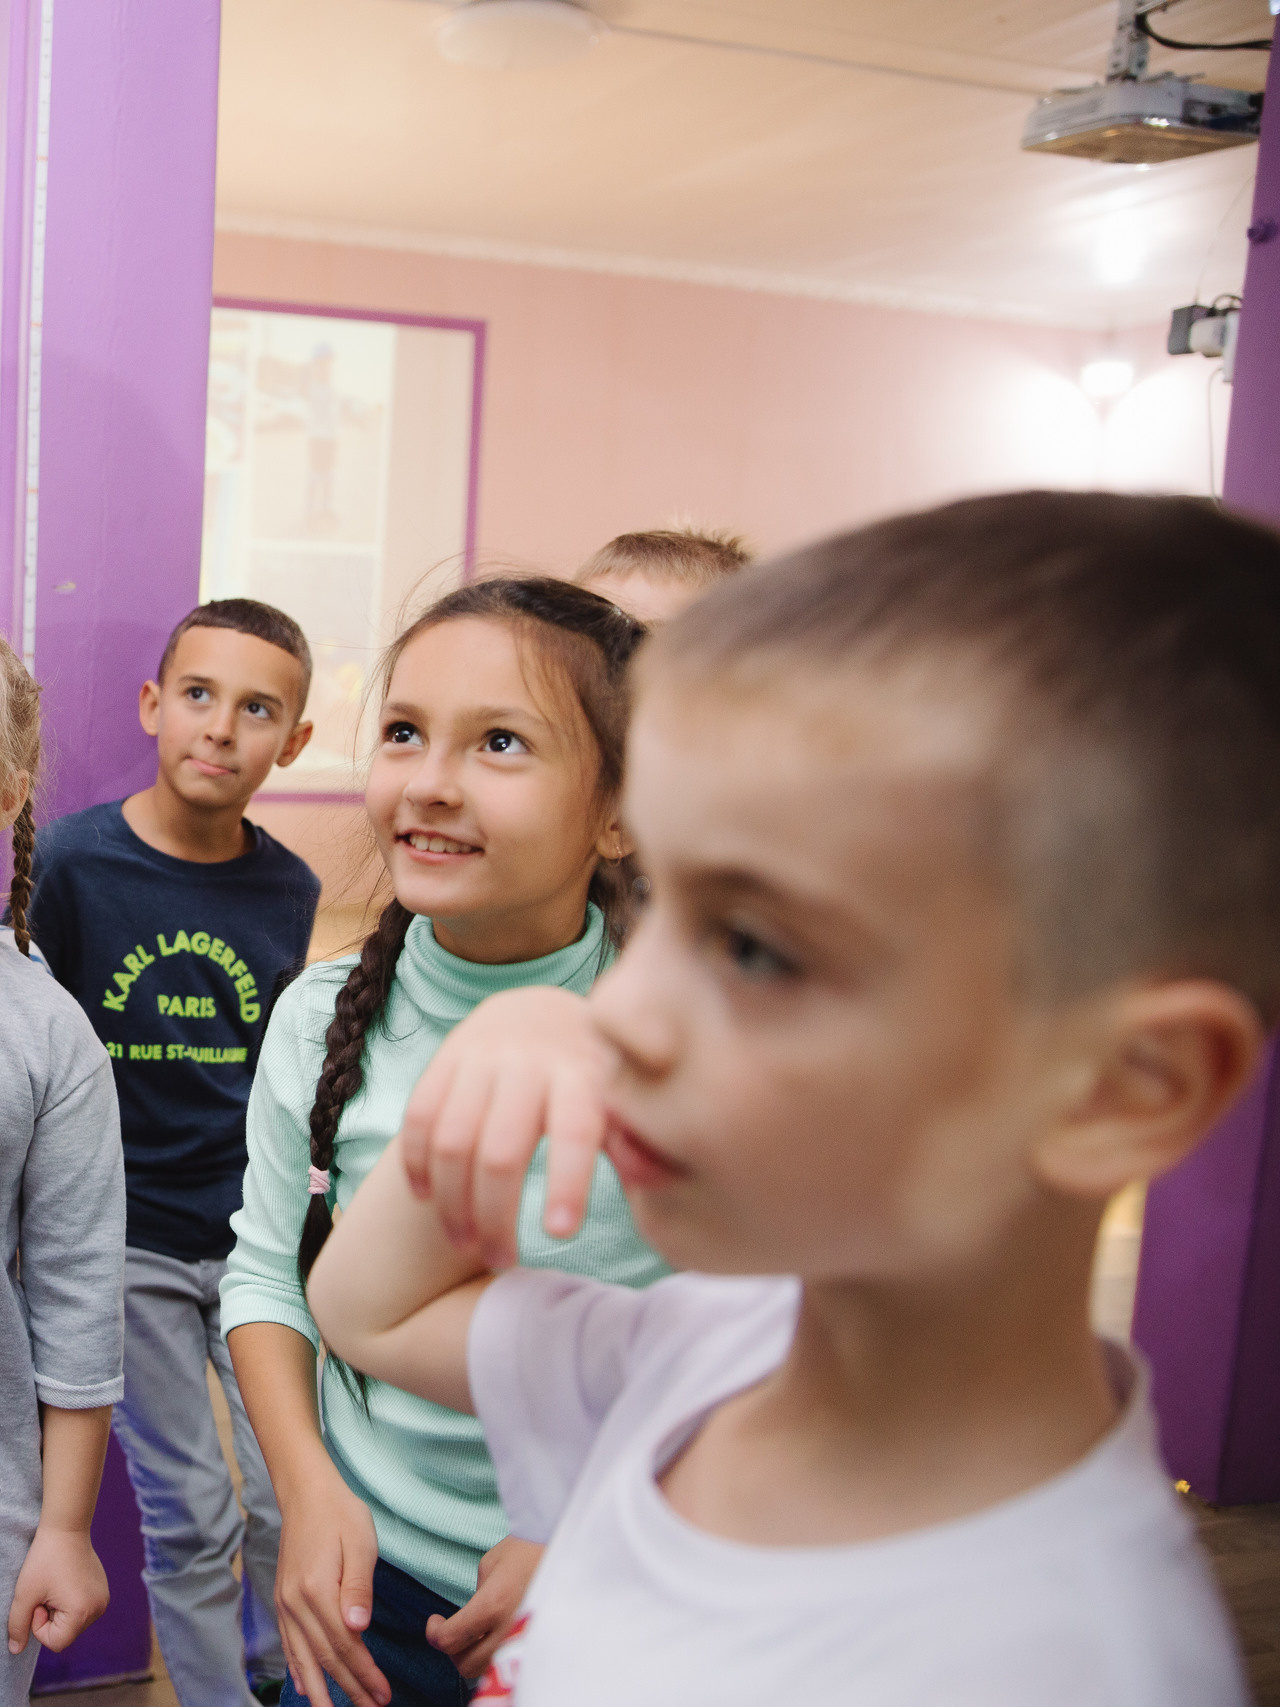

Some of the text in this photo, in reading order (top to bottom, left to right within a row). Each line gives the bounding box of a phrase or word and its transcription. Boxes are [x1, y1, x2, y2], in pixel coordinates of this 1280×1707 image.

[102, 929, 261, 1024] KARL LAGERFELD
[157, 994, 217, 1018] PARIS
[105, 1041, 124, 1059] 21
[129, 1043, 163, 1060] RUE
